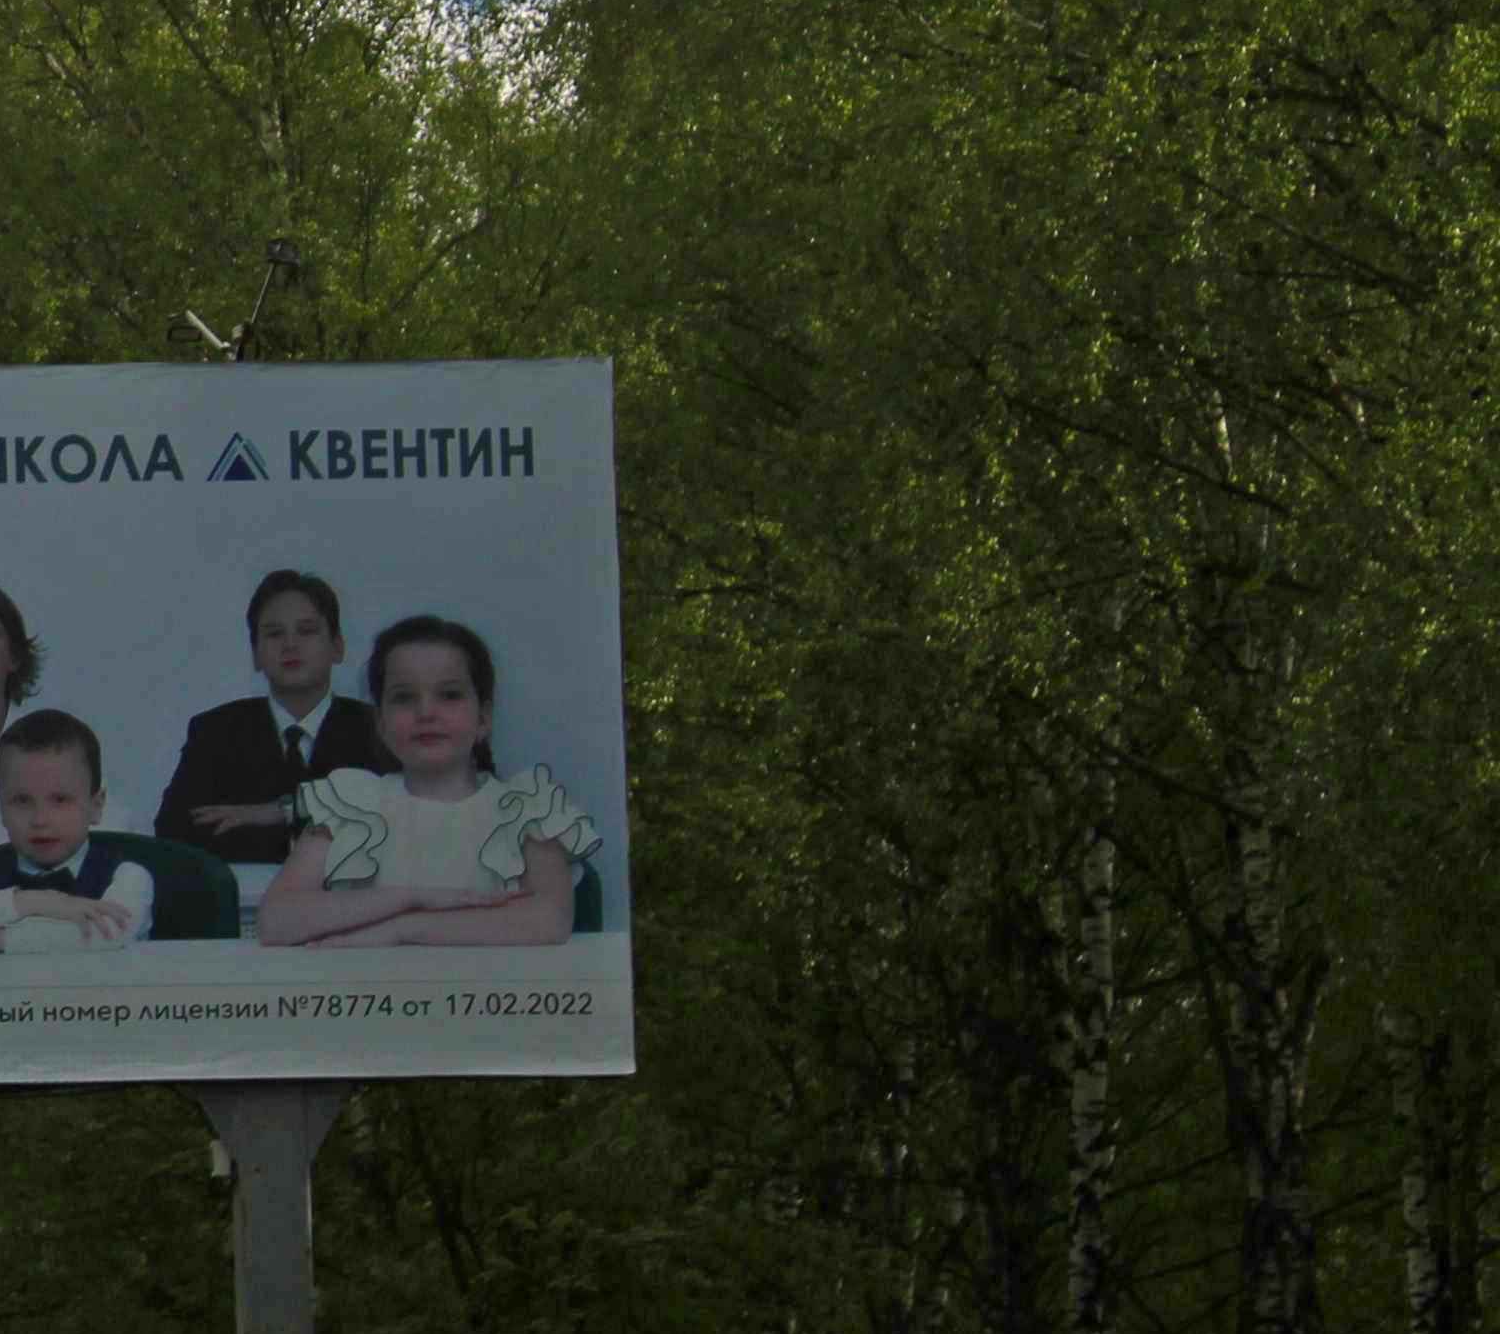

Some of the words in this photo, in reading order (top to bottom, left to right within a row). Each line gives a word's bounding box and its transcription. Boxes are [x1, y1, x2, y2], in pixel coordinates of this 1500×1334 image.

[289, 426, 535, 480] КВЕНТИН
[43, 1003, 131, 1026] номер
[139, 1000, 269, 1024] лицензии
[277, 994, 394, 1018] №78774
[403, 998, 432, 1017] от
[445, 992, 593, 1016] 17.02.2022
